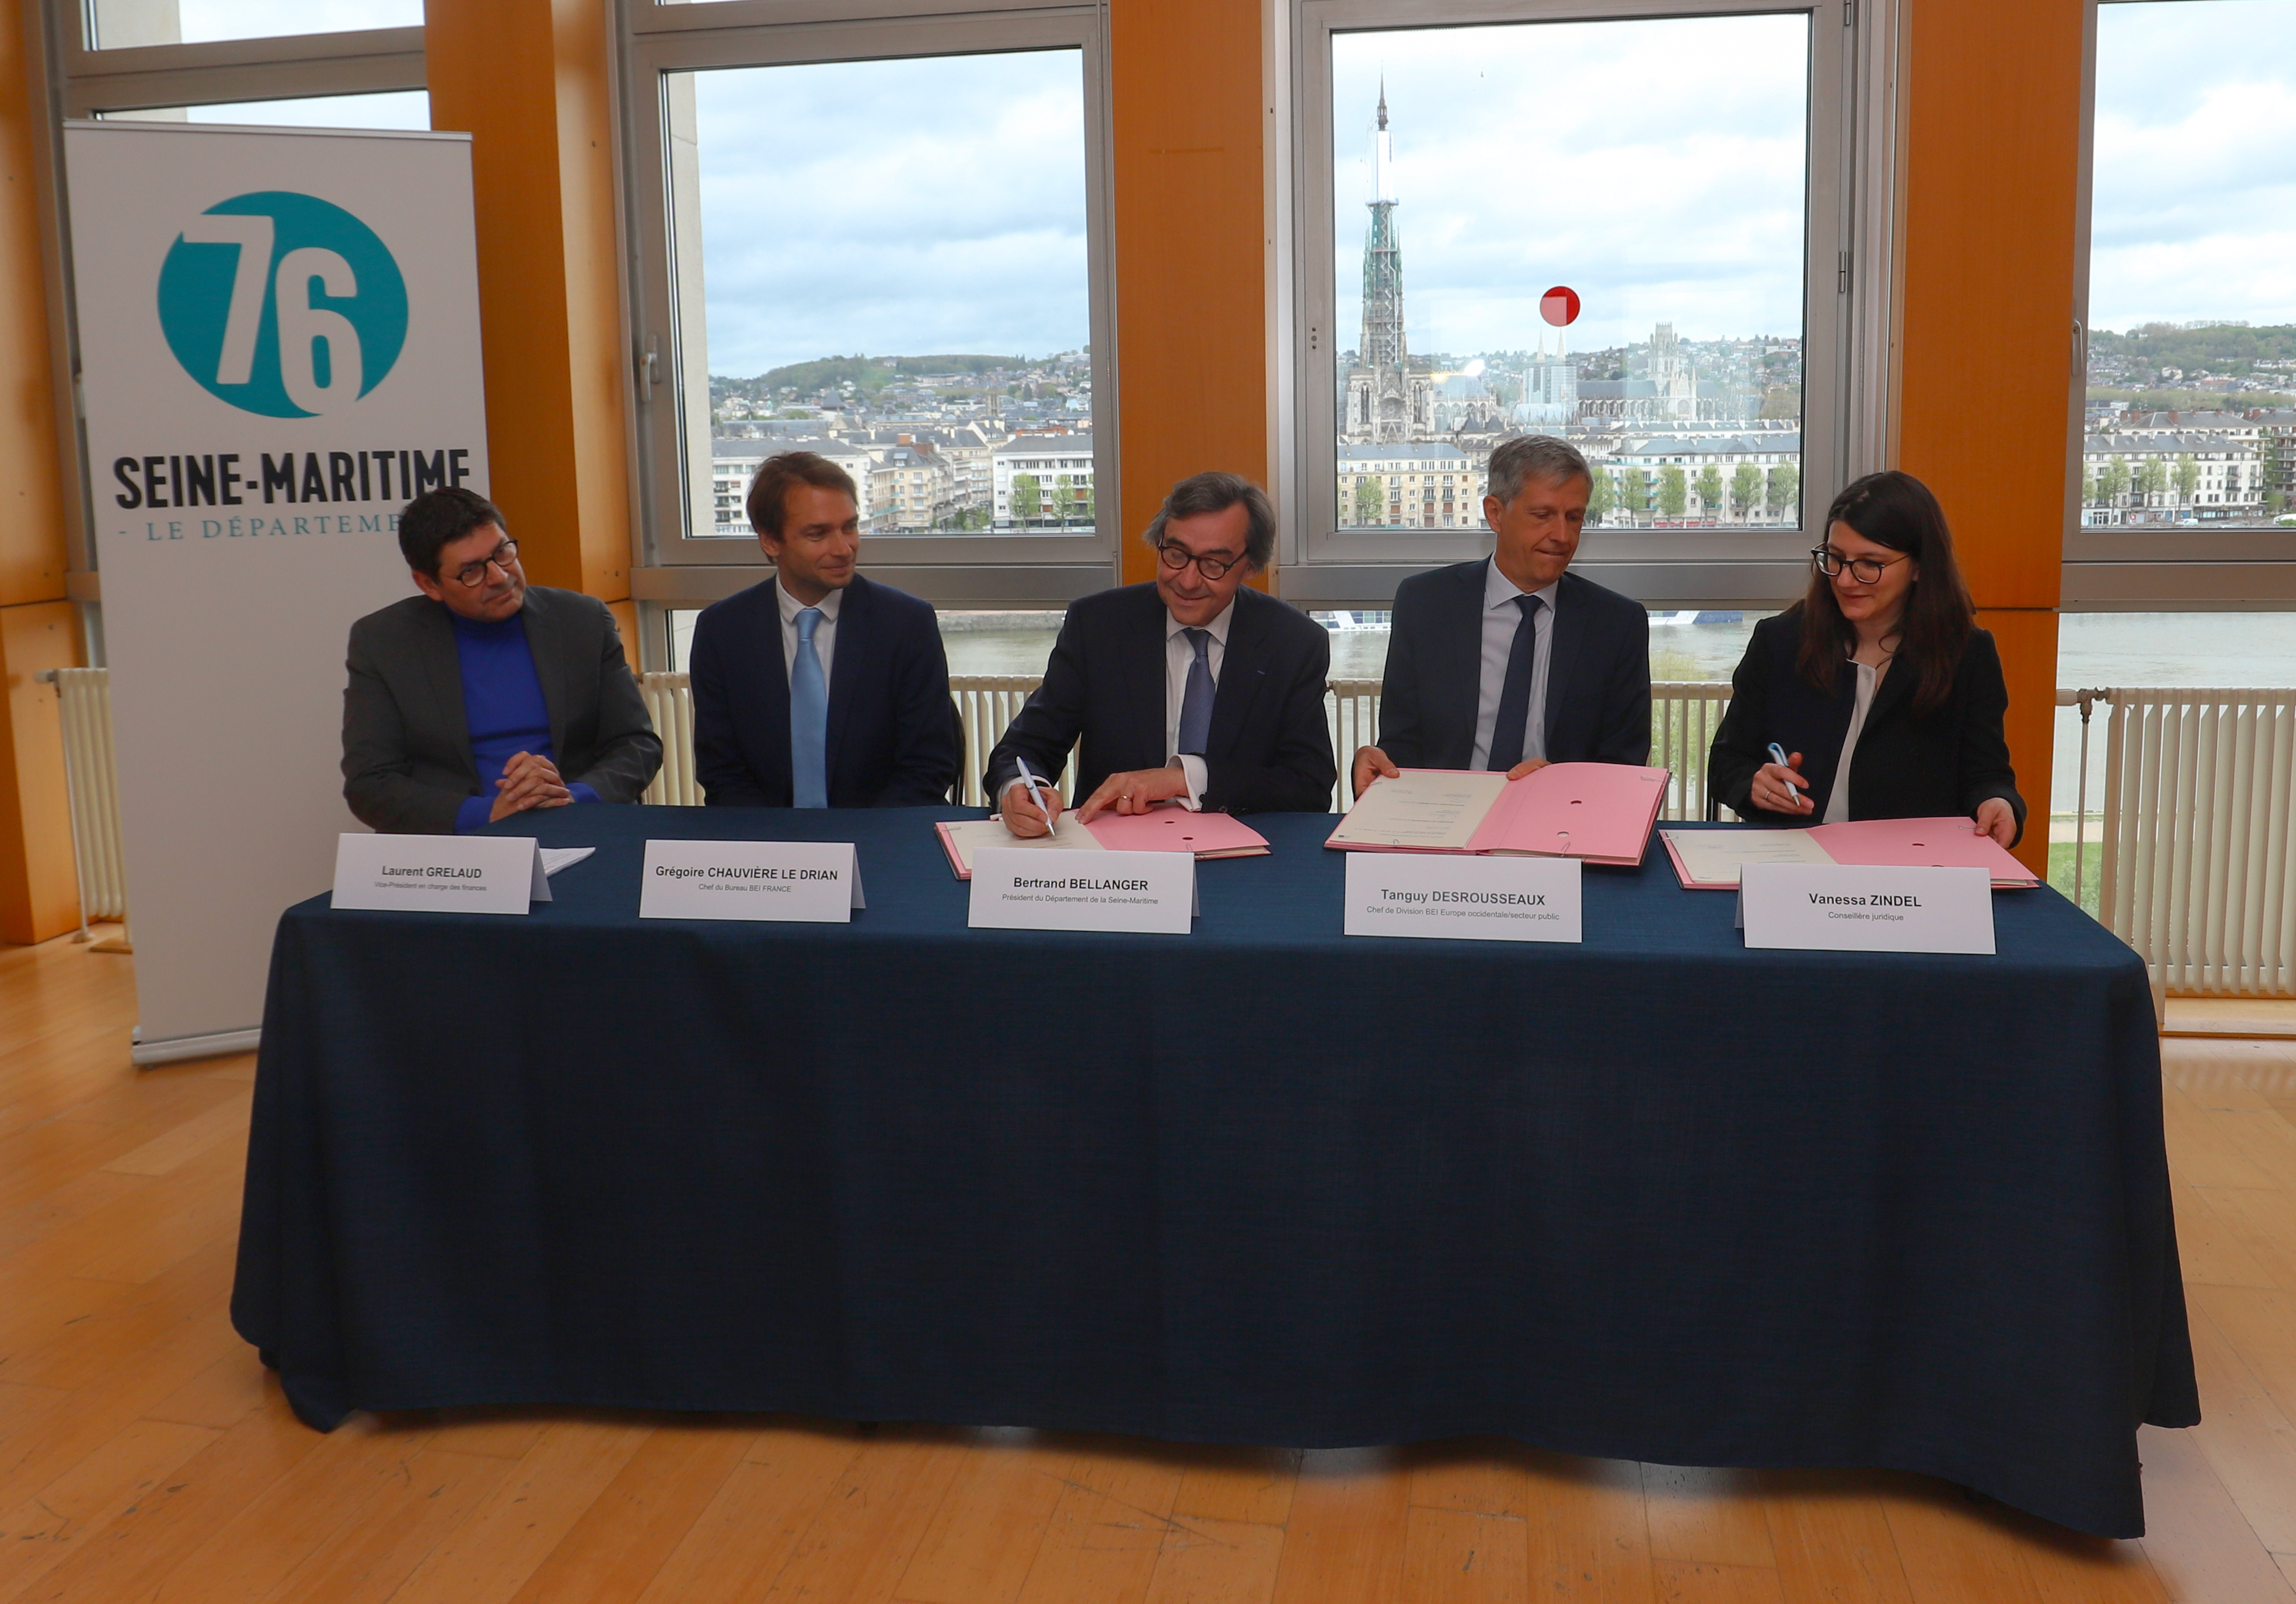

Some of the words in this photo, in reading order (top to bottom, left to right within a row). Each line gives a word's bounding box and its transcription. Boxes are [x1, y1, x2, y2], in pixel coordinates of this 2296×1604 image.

[180, 214, 363, 415] 76
[113, 449, 470, 509] SEINE-MARITIME
[147, 522, 184, 541] LE
[203, 513, 400, 539] DÉPARTEME
[382, 865, 424, 877] Laurent
[426, 866, 482, 879] GRELAUD
[655, 866, 704, 880] Grégoire
[707, 865, 778, 879] CHAUVIÈRE
[781, 869, 797, 879] LE
[800, 869, 838, 880] DRIAN
[427, 883, 448, 892] charge
[698, 883, 714, 891] Chef
[762, 885, 792, 893] FRANCE
[1013, 877, 1066, 889] Bertrand
[1069, 878, 1149, 891] BELLANGER
[1002, 893, 1034, 902] Président
[1045, 894, 1088, 904] Département
[1108, 896, 1159, 905] Seine-Maritime
[1381, 889, 1428, 904] Tanguy
[1432, 891, 1546, 906] DESROUSSEAUX
[1808, 893, 1866, 906] Vanessa
[1870, 894, 1922, 907] ZINDEL
[1366, 906, 1384, 914] Chef
[1395, 907, 1424, 915] Division
[1425, 908, 1439, 916] BEI
[1440, 908, 1466, 918] Europe
[1467, 910, 1537, 920] occidentale/secteur
[1538, 913, 1560, 921] public
[1828, 911, 1870, 921] Conseillère
[1871, 912, 1904, 922] juridique
